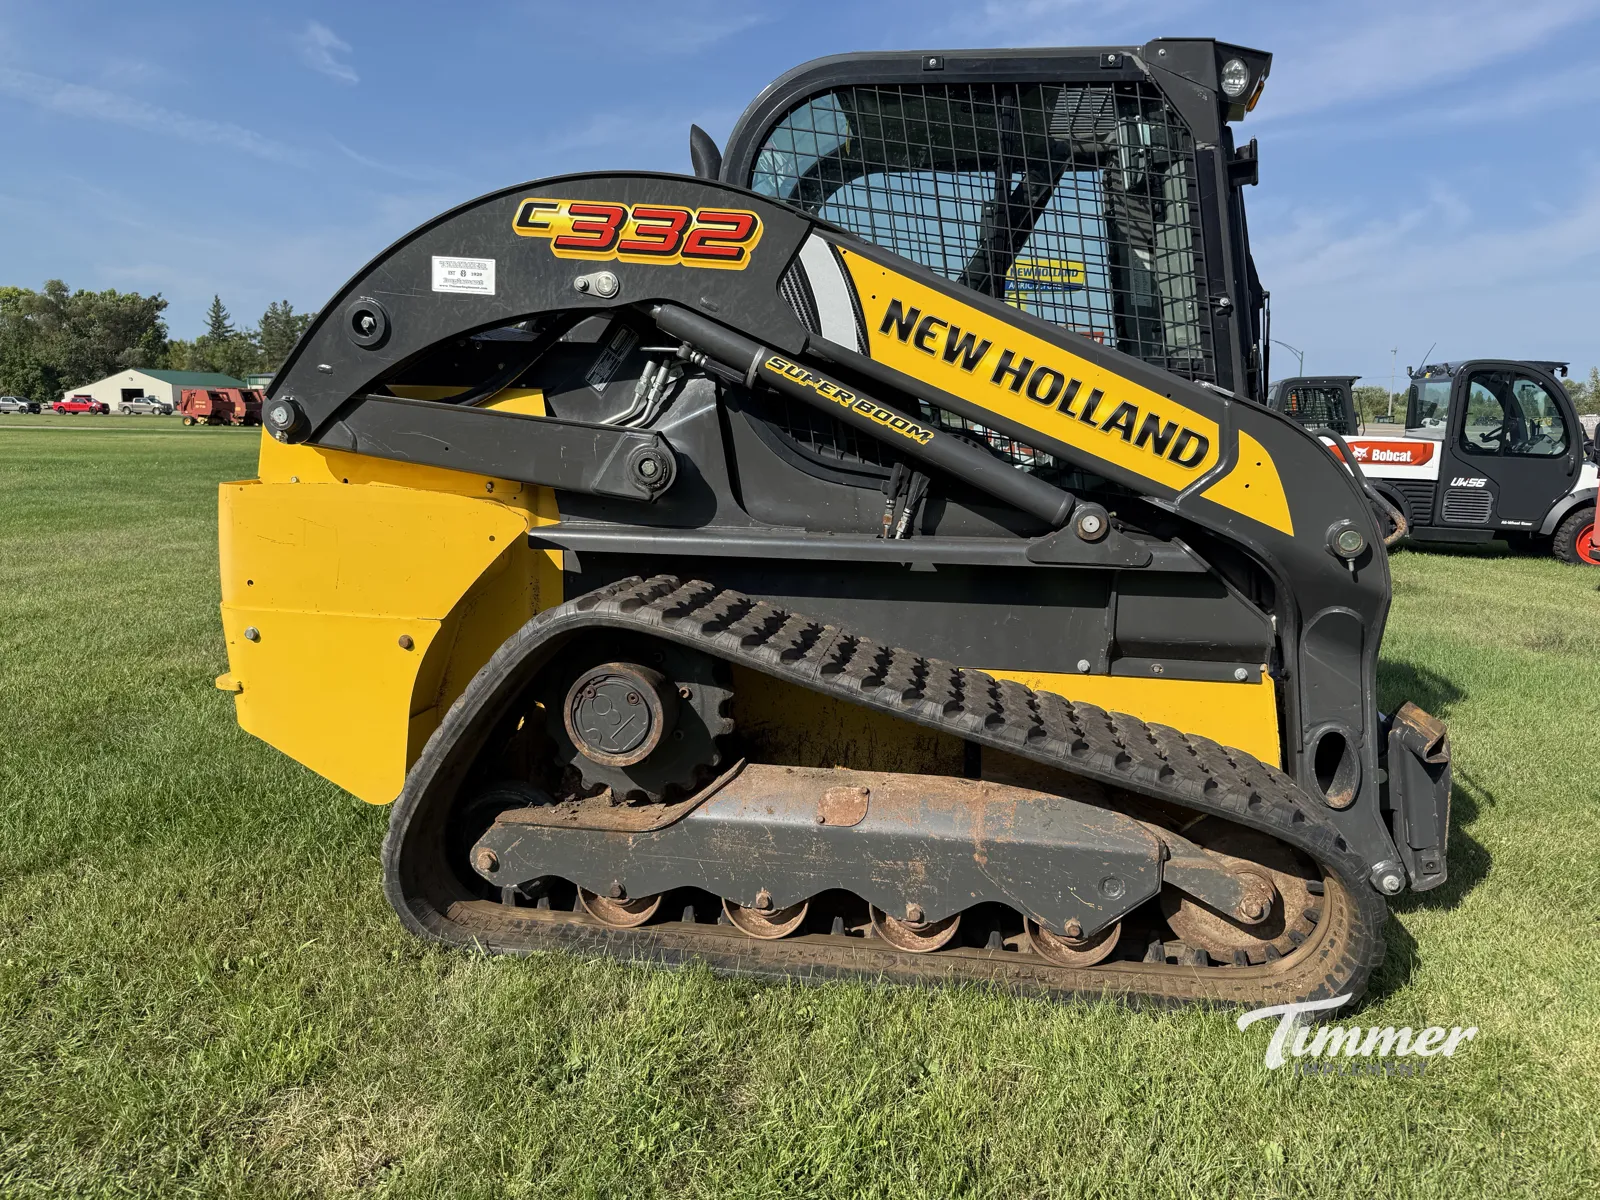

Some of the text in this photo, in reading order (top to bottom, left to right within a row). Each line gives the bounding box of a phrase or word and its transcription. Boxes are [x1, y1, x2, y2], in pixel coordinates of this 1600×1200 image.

[514, 199, 761, 266] C332
[1010, 267, 1032, 277] NEW
[765, 356, 934, 445] SUPER BOOM
[878, 298, 1210, 469] NEW HOLLAND
[1372, 449, 1411, 462] Bobcat
[1450, 477, 1487, 488] UW56
